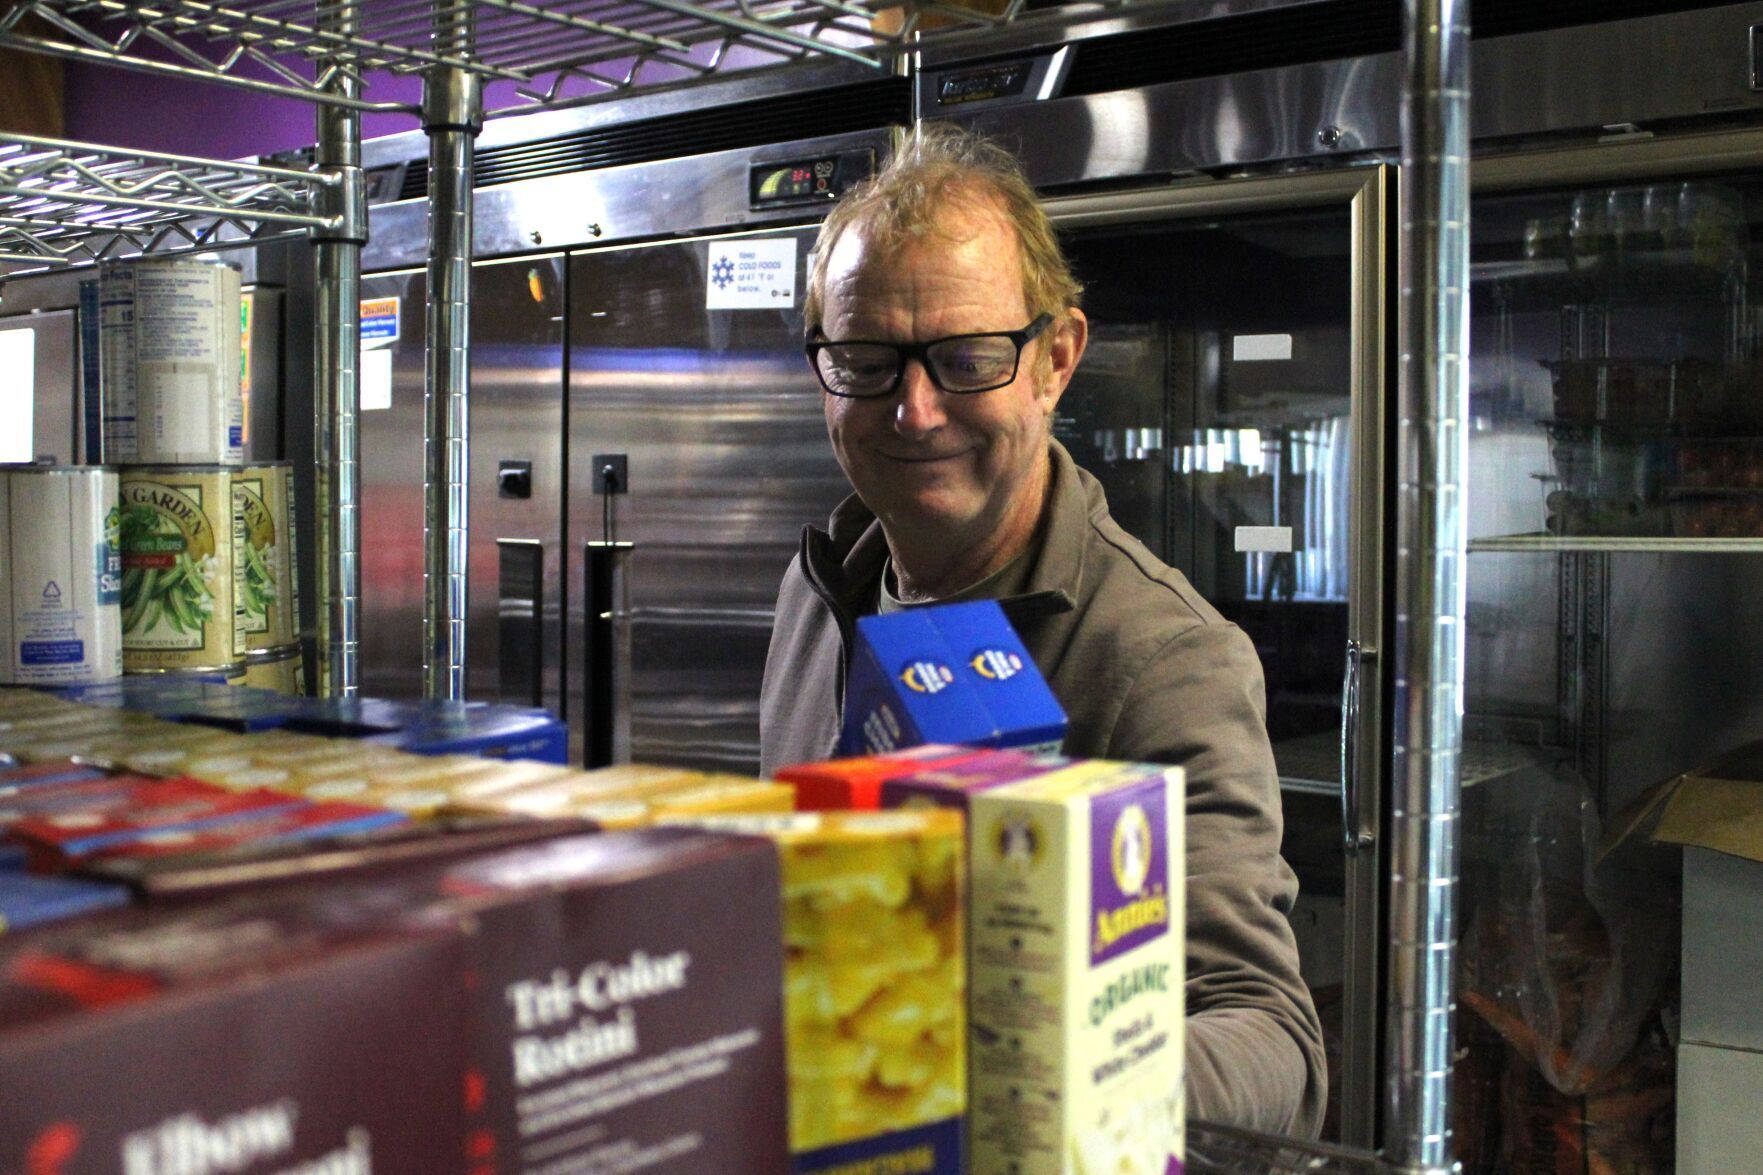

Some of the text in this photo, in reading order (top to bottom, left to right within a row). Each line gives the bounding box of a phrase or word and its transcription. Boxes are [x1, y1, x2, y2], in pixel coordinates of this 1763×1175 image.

[738, 260, 782, 270] COLD FOODS
[121, 310, 134, 322] 15
[133, 485, 206, 537] GARDEN
[157, 537, 183, 551] Beans
[506, 950, 690, 1030] Tri-Color
[1089, 963, 1169, 1026] ORGANIC
